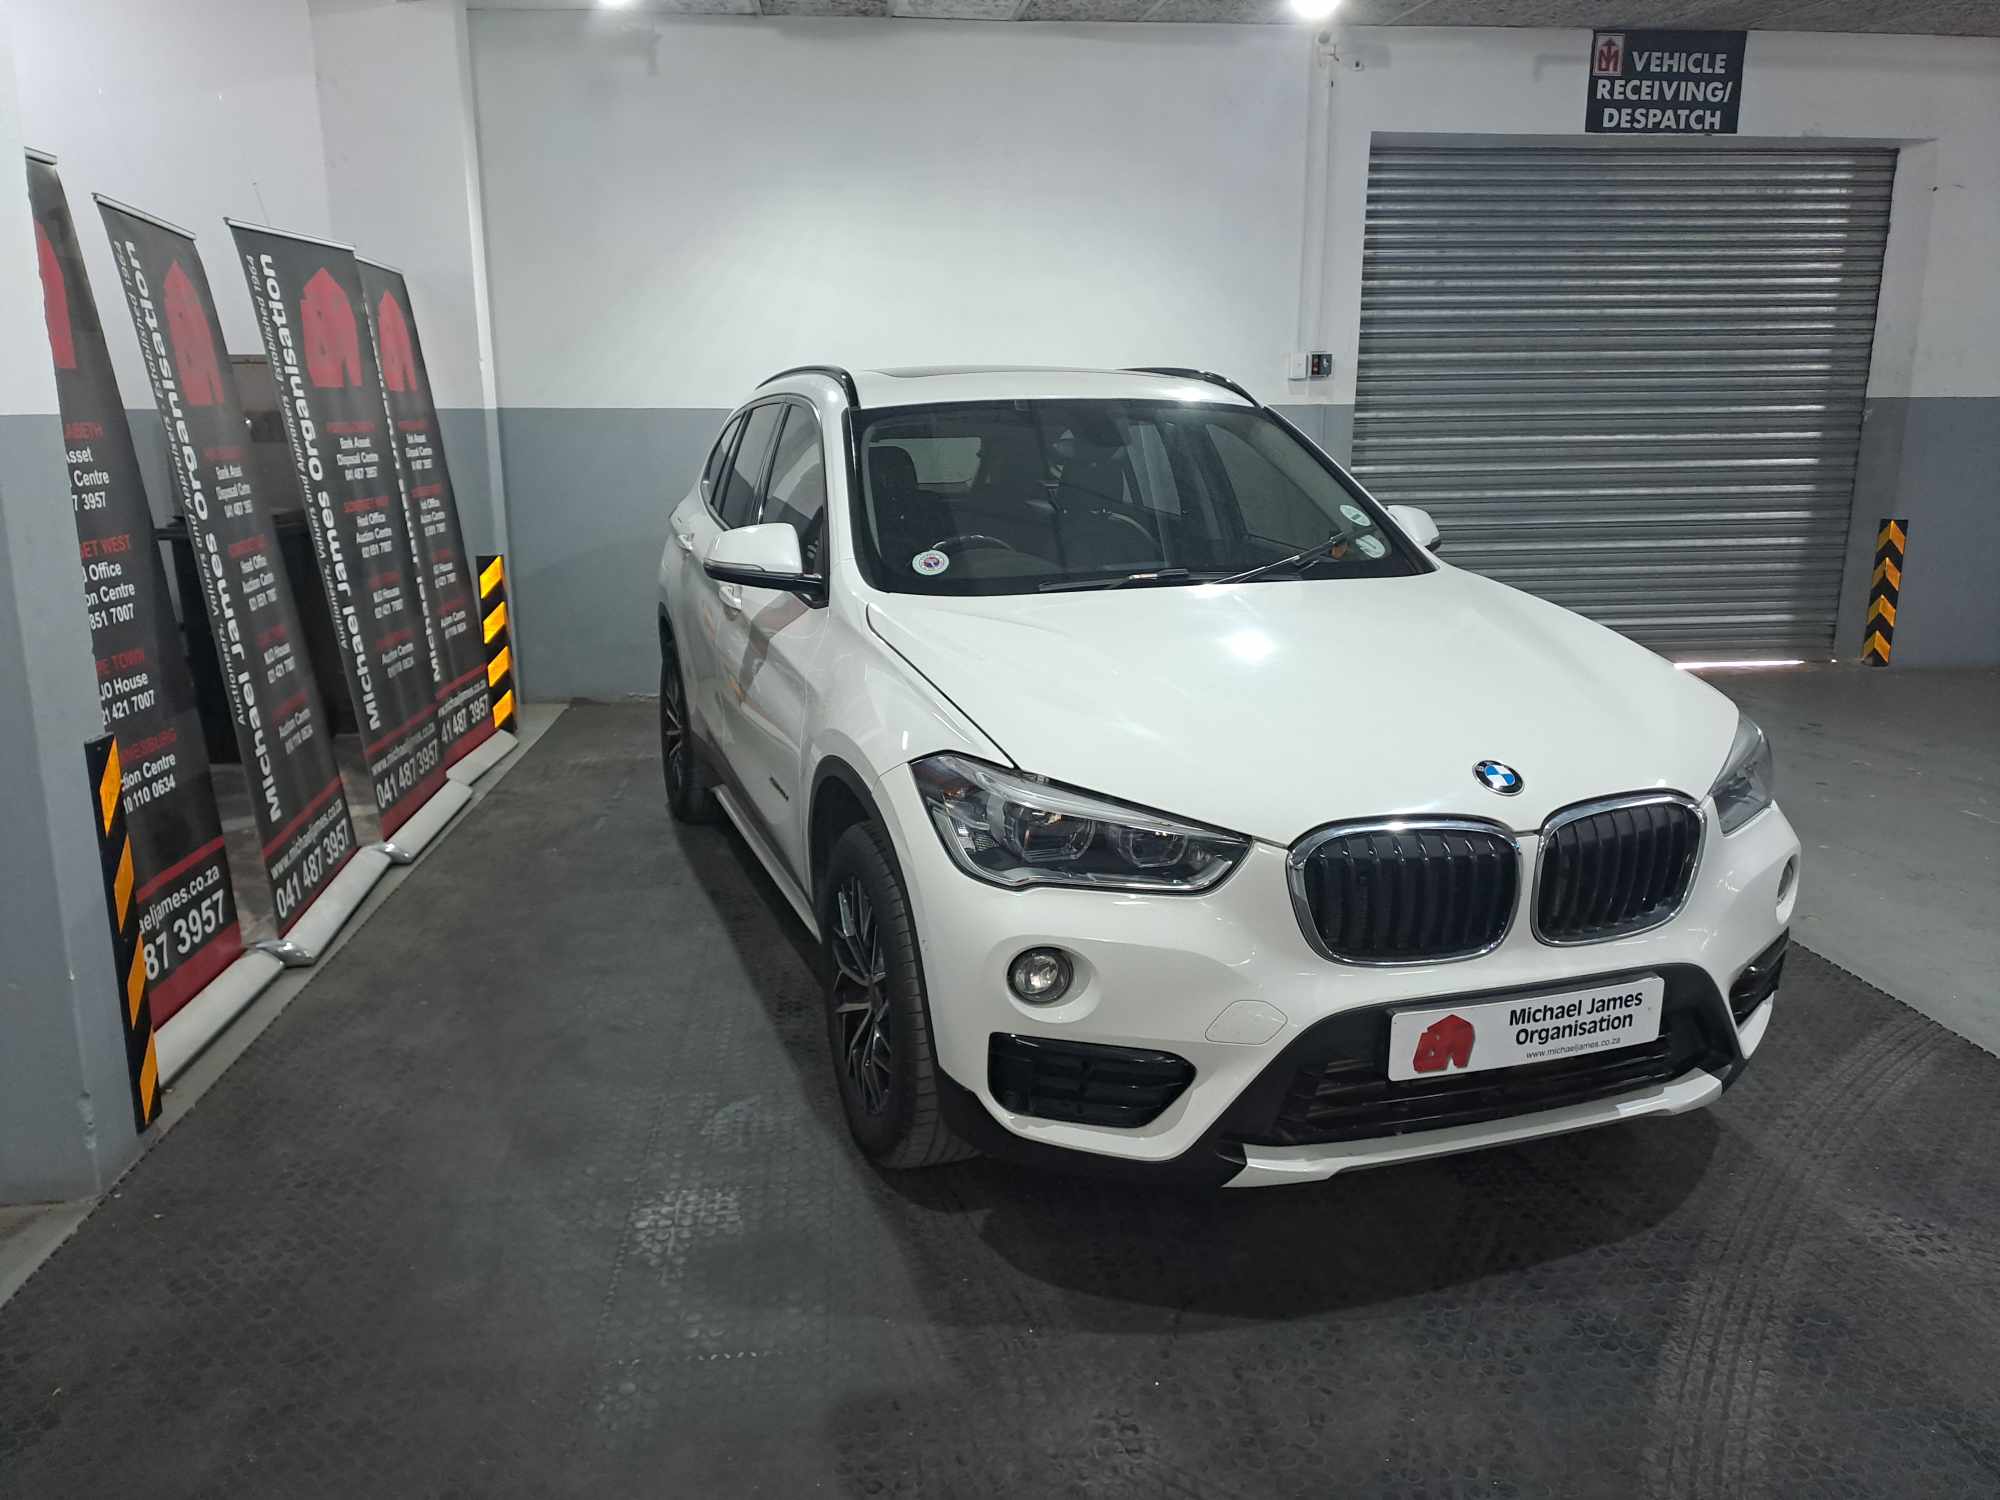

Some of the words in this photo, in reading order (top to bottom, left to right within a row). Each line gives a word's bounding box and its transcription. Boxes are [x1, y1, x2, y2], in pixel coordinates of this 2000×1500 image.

[1632, 51, 1727, 74] VEHICLE
[1596, 79, 1733, 102] RECEIVING/
[1602, 107, 1721, 130] DESPATCH
[124, 240, 208, 521] Organisation
[259, 253, 324, 482] Organisation
[73, 469, 110, 487] Centre
[81, 491, 106, 511] 3957
[188, 513, 203, 549] and
[317, 490, 351, 597] James
[89, 561, 122, 582] Office
[100, 583, 136, 603] Centre
[205, 532, 246, 661] James
[89, 610, 109, 630] 851
[109, 603, 134, 624] 7007
[113, 673, 149, 696] House
[342, 605, 381, 732] Michael
[112, 699, 131, 720] 421
[131, 689, 155, 713] 7007
[453, 707, 468, 736] 487
[469, 693, 489, 724] 3957
[237, 671, 283, 823] Michael
[142, 753, 176, 778] Centre
[376, 773, 399, 809] 041
[398, 757, 417, 791] 487
[416, 738, 438, 774] 3957
[133, 785, 151, 809] 110
[151, 773, 176, 798] 0634
[276, 871, 302, 919] 041
[302, 846, 323, 888] 487
[323, 818, 350, 865] 3957
[143, 930, 170, 982] 87
[173, 888, 224, 955] 3957
[1509, 999, 1582, 1027] Michael
[1586, 992, 1643, 1015] James
[1516, 1013, 1633, 1045] Organisation
